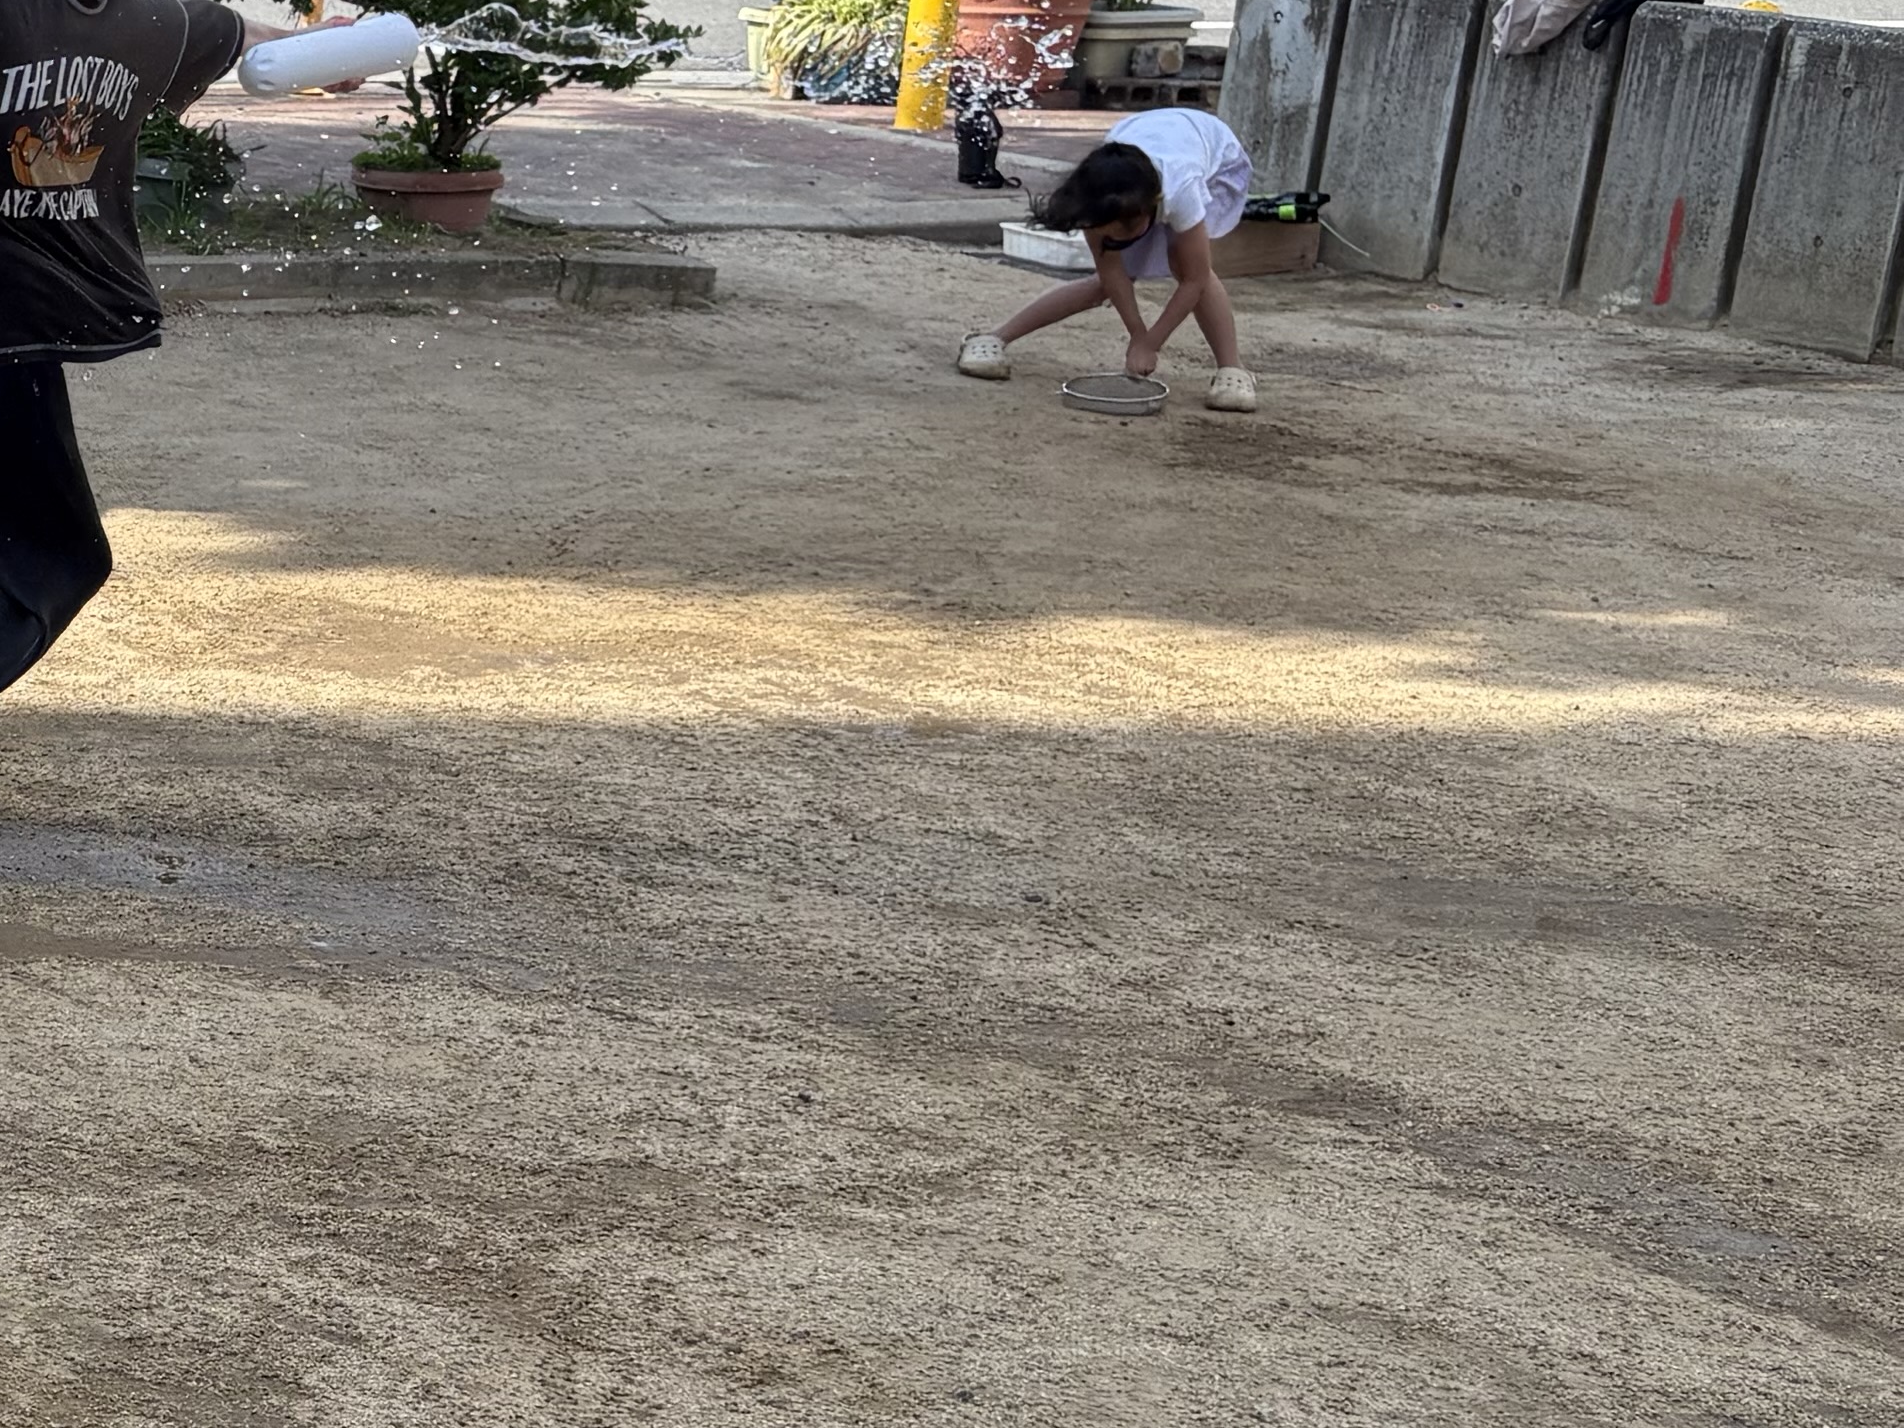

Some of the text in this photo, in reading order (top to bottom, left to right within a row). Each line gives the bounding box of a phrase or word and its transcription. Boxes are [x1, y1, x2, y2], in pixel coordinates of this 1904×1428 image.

[0, 55, 140, 121] THE LOST BOYS
